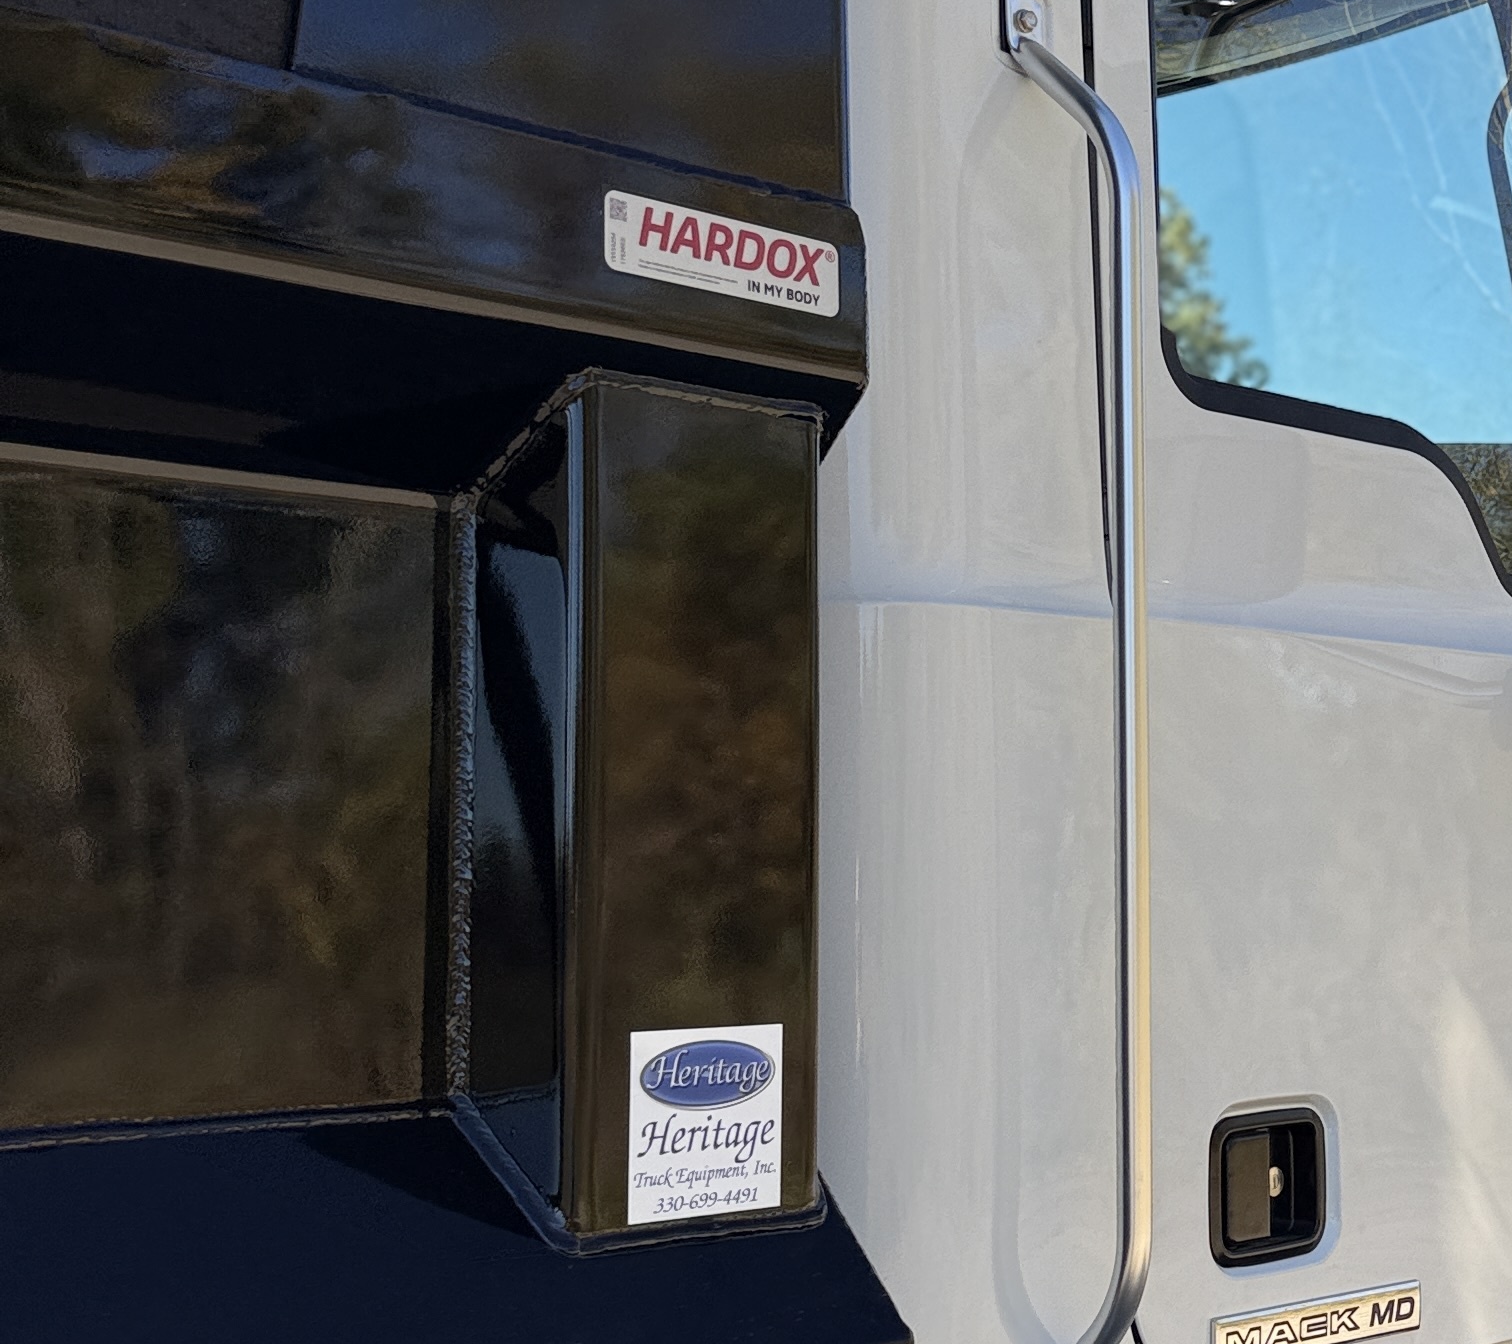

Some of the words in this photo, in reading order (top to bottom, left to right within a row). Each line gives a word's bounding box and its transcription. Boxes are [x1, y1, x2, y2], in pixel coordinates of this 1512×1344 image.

[747, 279, 761, 294] IN
[764, 284, 783, 299] MY
[786, 288, 820, 306] BODY
[646, 1049, 770, 1093] Heritage
[636, 1113, 776, 1164] Heritage
[633, 1166, 674, 1189] Truck
[675, 1164, 749, 1189] Equipment,
[754, 1160, 776, 1175] Inc.
[653, 1187, 759, 1215] 330-699-4491
[1369, 1296, 1415, 1327] MD
